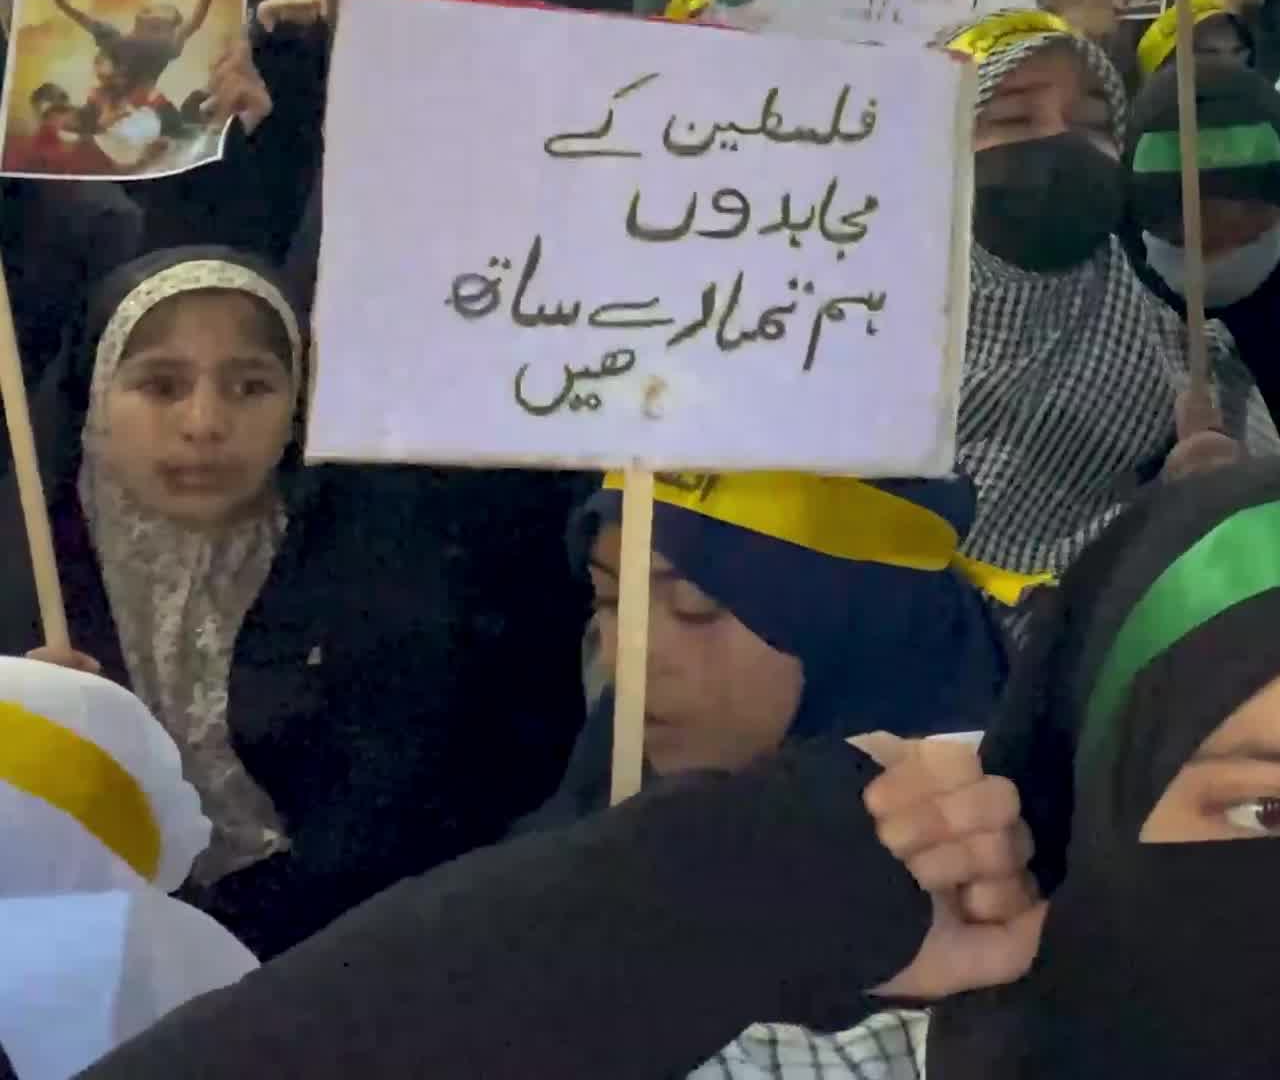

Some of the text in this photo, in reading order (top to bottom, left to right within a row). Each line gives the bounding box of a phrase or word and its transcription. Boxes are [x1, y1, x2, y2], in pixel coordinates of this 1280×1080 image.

[543, 71, 878, 159] فلسطین کے
[625, 176, 880, 260] مجاہدوں
[444, 235, 582, 328] ساتھ
[801, 281, 887, 372] ہم
